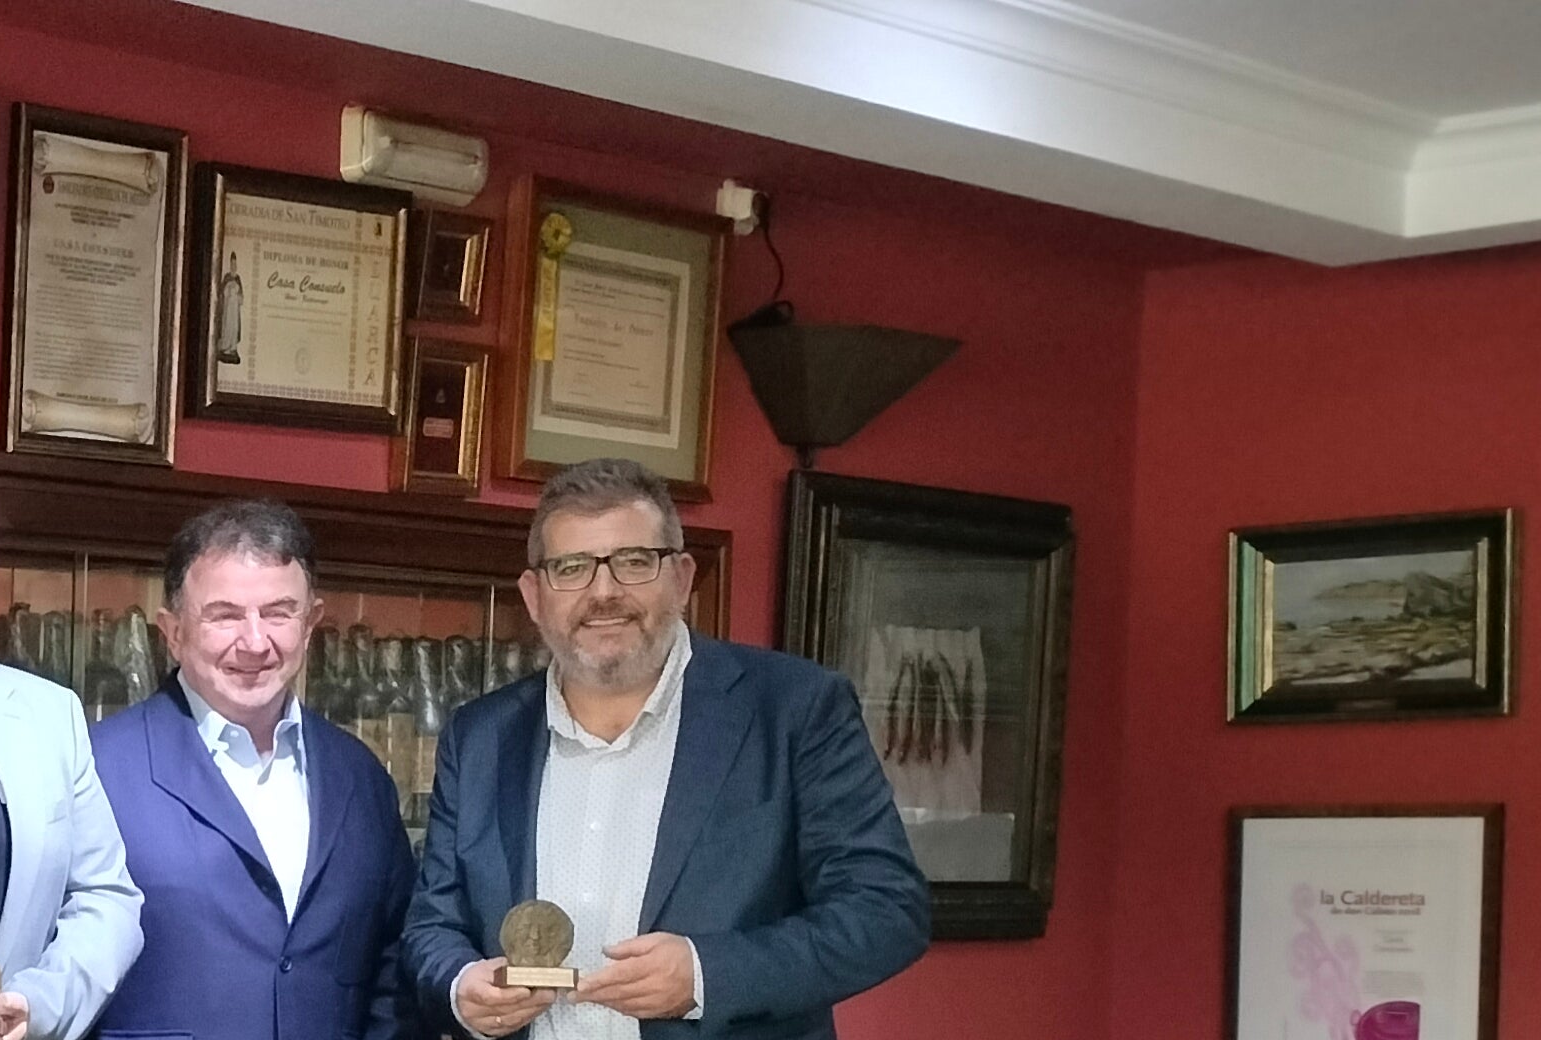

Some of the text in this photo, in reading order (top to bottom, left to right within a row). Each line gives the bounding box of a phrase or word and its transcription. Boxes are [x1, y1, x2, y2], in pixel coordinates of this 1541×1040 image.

[267, 271, 346, 295] Casa Consuelo
[1320, 889, 1426, 906] la Caldereta
